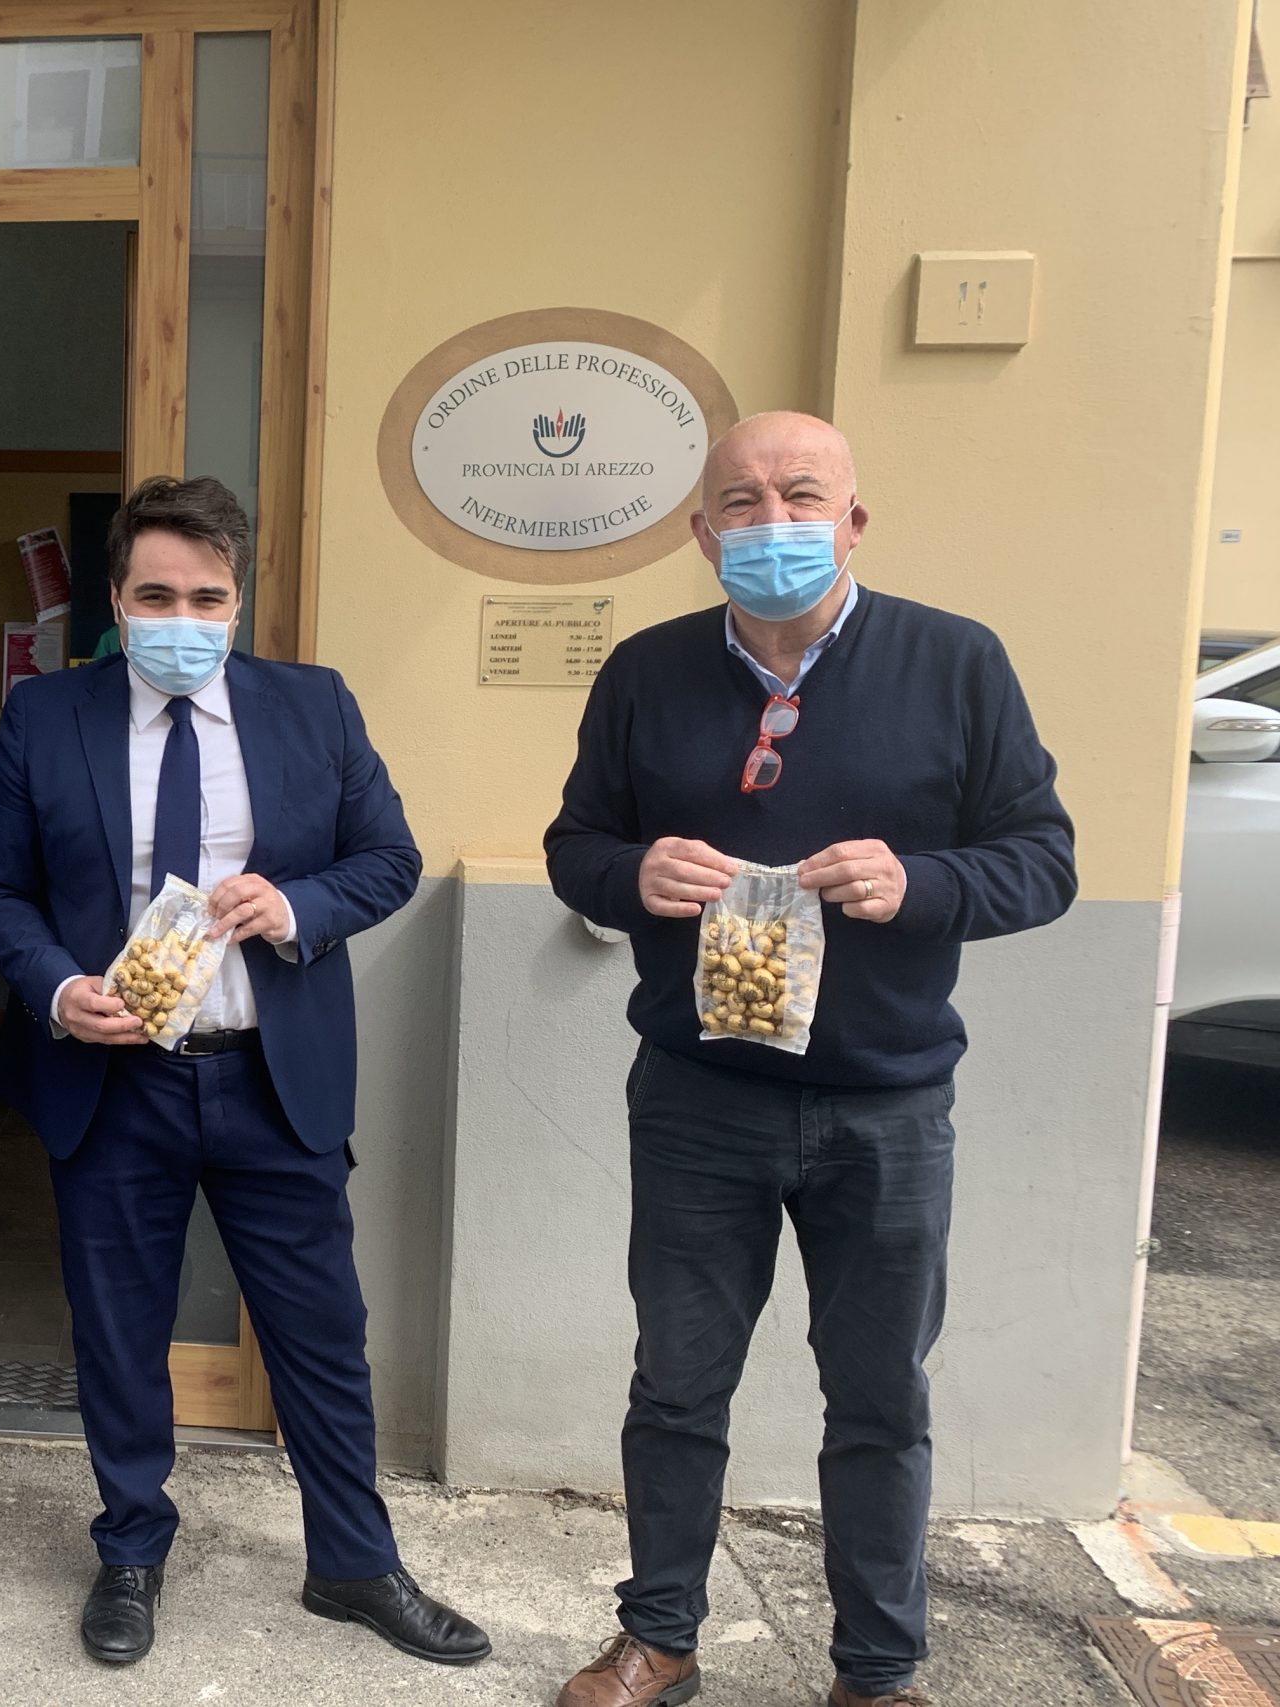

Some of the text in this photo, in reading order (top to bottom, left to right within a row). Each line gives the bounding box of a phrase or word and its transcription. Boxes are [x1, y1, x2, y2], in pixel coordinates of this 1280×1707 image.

[427, 353, 695, 429] ORDINE DELLE PROFESSIONI
[462, 462, 654, 477] PROVINCIA DI AREZZO
[460, 495, 653, 538] INFERMIERISTICHE
[494, 620, 601, 628] APERTURE AL PUBBLICO
